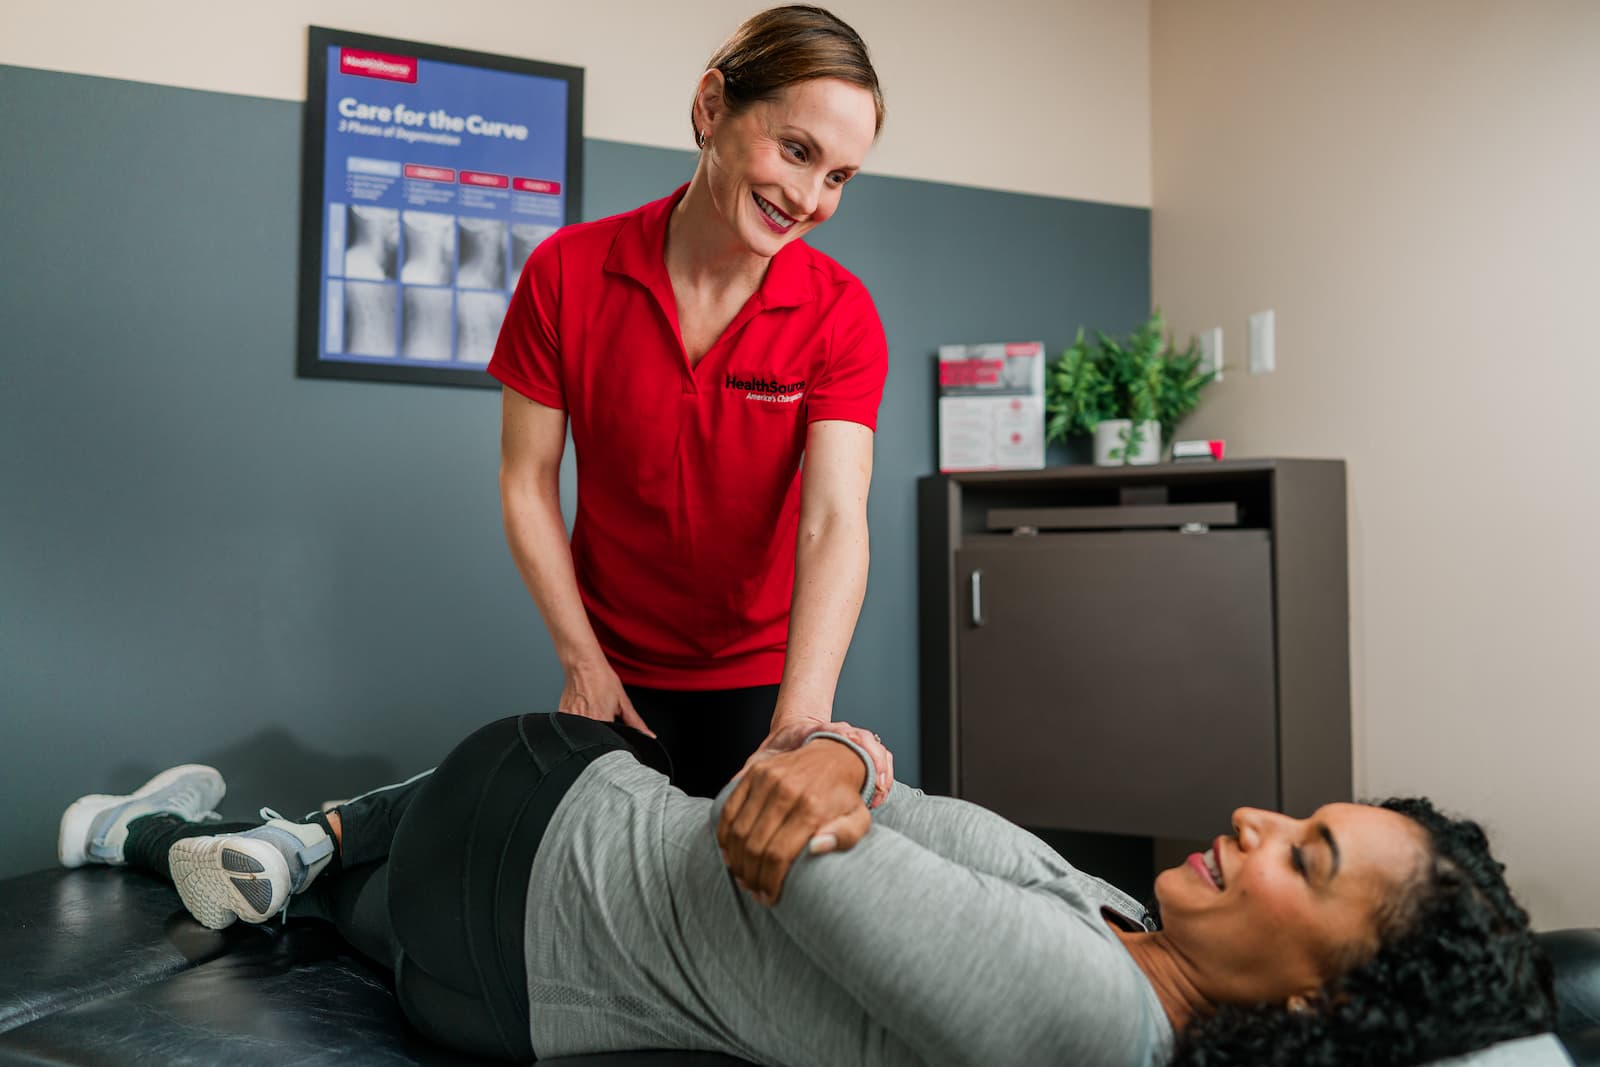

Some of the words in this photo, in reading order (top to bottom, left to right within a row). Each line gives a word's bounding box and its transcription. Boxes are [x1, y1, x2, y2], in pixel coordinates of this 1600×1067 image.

[338, 97, 392, 122] Care
[394, 103, 426, 127] for
[428, 109, 464, 133] the
[465, 114, 529, 140] Curve
[383, 125, 396, 138] of
[746, 392, 777, 402] America's
